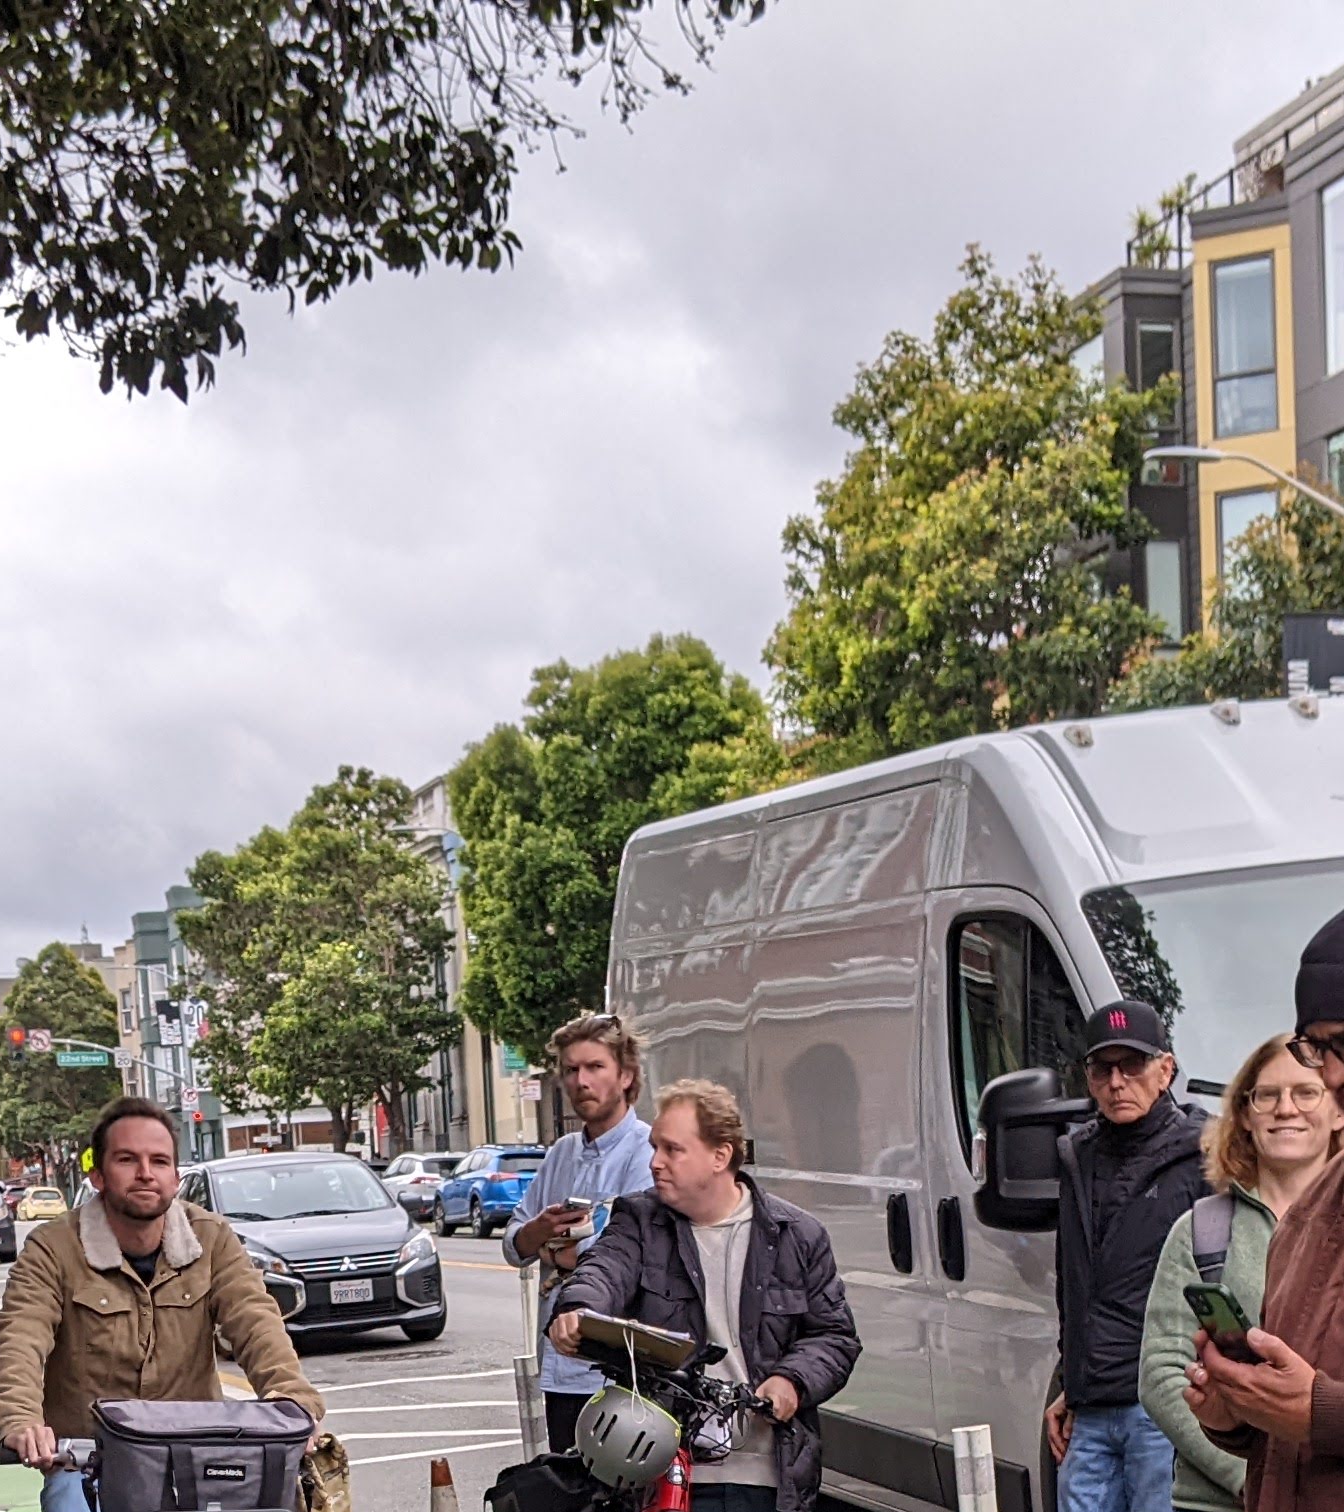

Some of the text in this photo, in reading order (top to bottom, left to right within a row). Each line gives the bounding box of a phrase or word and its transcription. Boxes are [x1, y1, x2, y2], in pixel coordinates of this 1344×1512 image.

[61, 1055, 104, 1063] 22nd Street
[117, 1057, 130, 1066] 20
